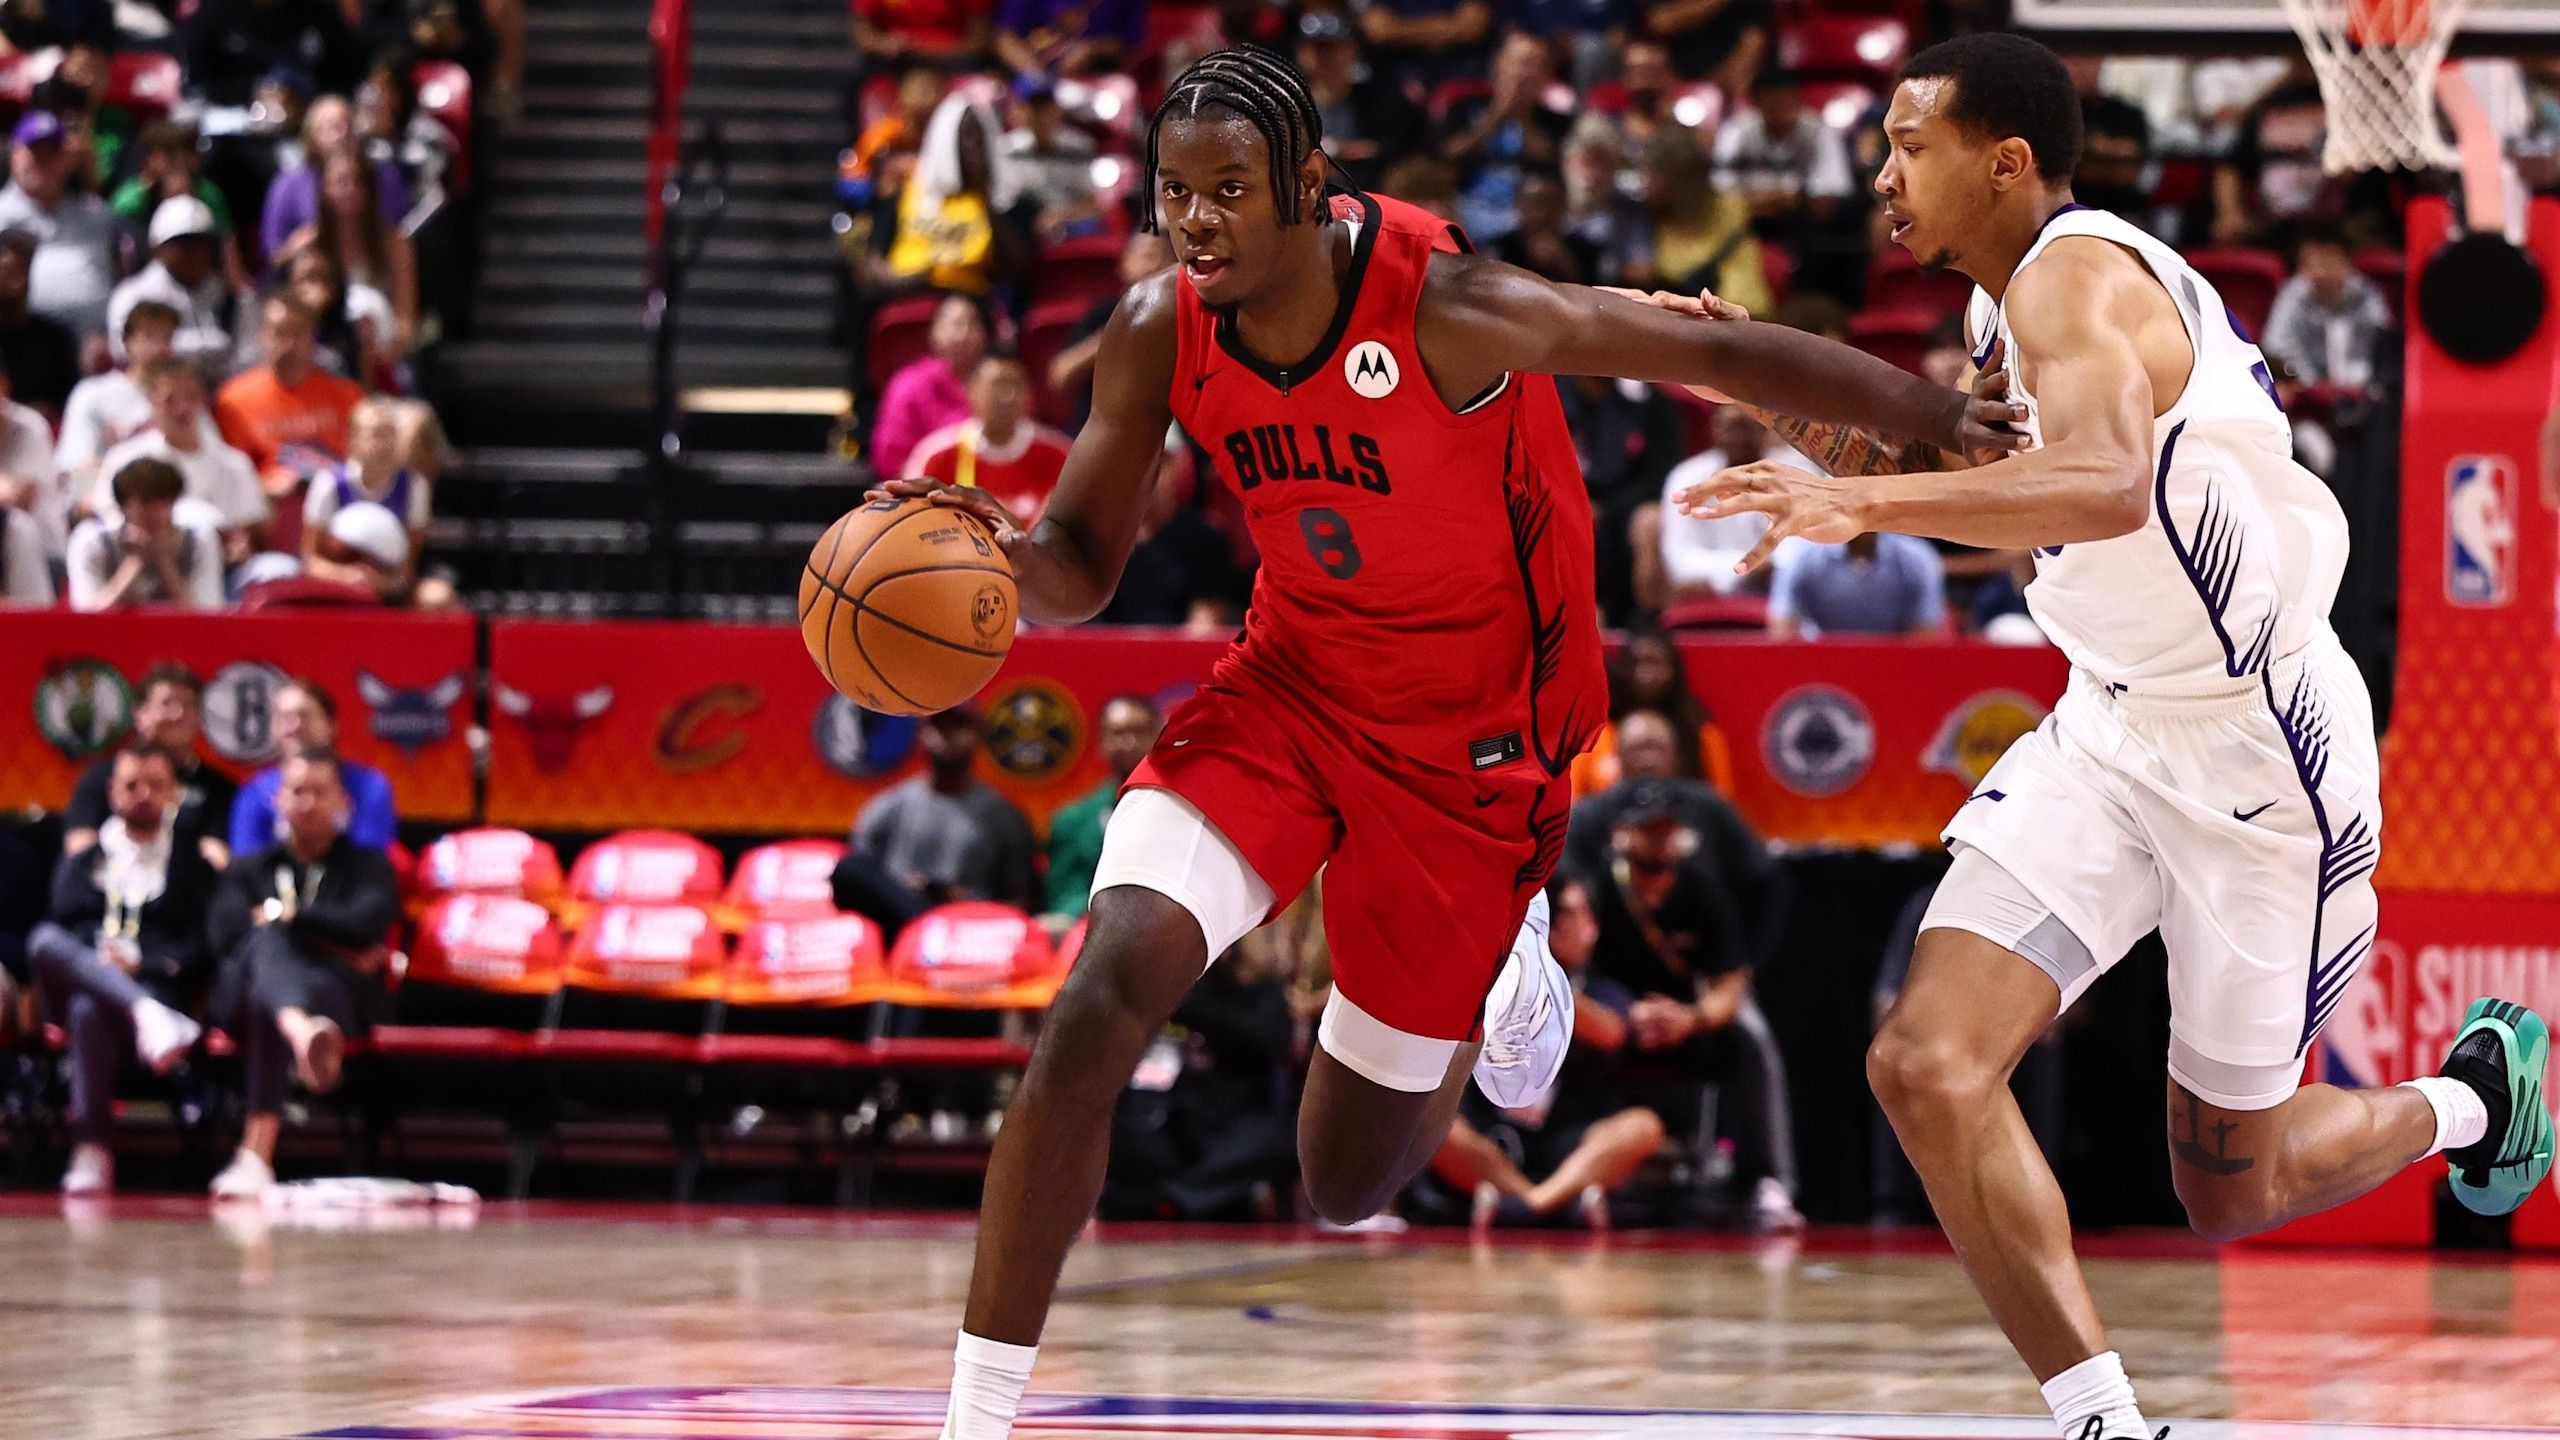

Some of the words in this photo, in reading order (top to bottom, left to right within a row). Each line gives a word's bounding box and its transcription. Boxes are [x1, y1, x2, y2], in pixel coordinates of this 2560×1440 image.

[1224, 423, 1392, 496] BULLS
[1298, 506, 1363, 581] 8
[1508, 741, 1515, 753] L
